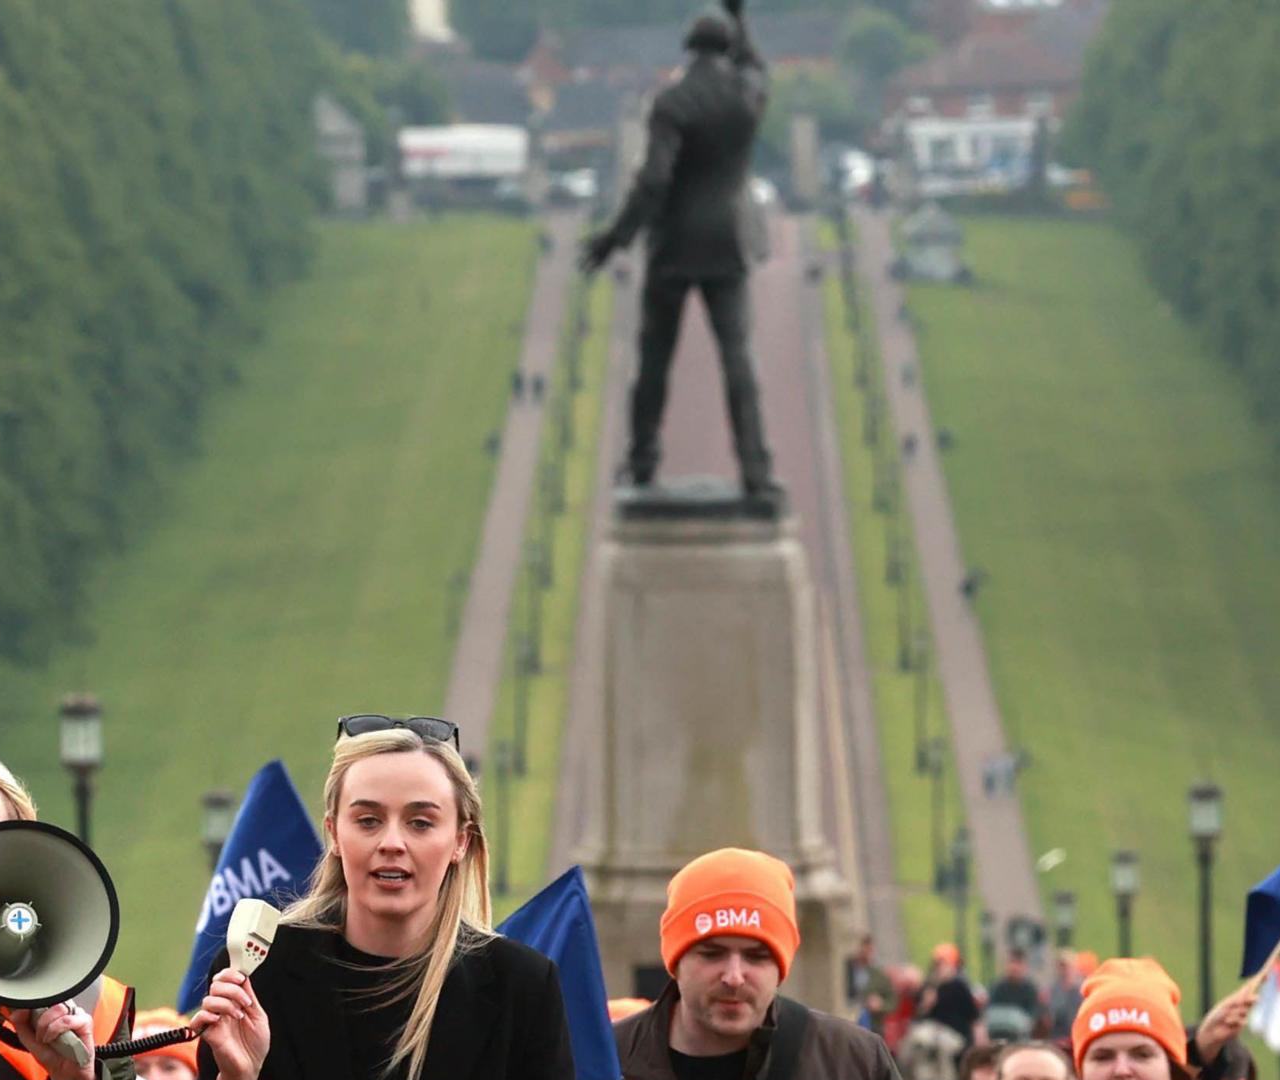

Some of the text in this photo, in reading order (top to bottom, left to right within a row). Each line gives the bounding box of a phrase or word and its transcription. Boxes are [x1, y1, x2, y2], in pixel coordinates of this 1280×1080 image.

[210, 848, 292, 917] BMA
[715, 908, 761, 929] BMA
[1107, 1008, 1151, 1027] BMA
